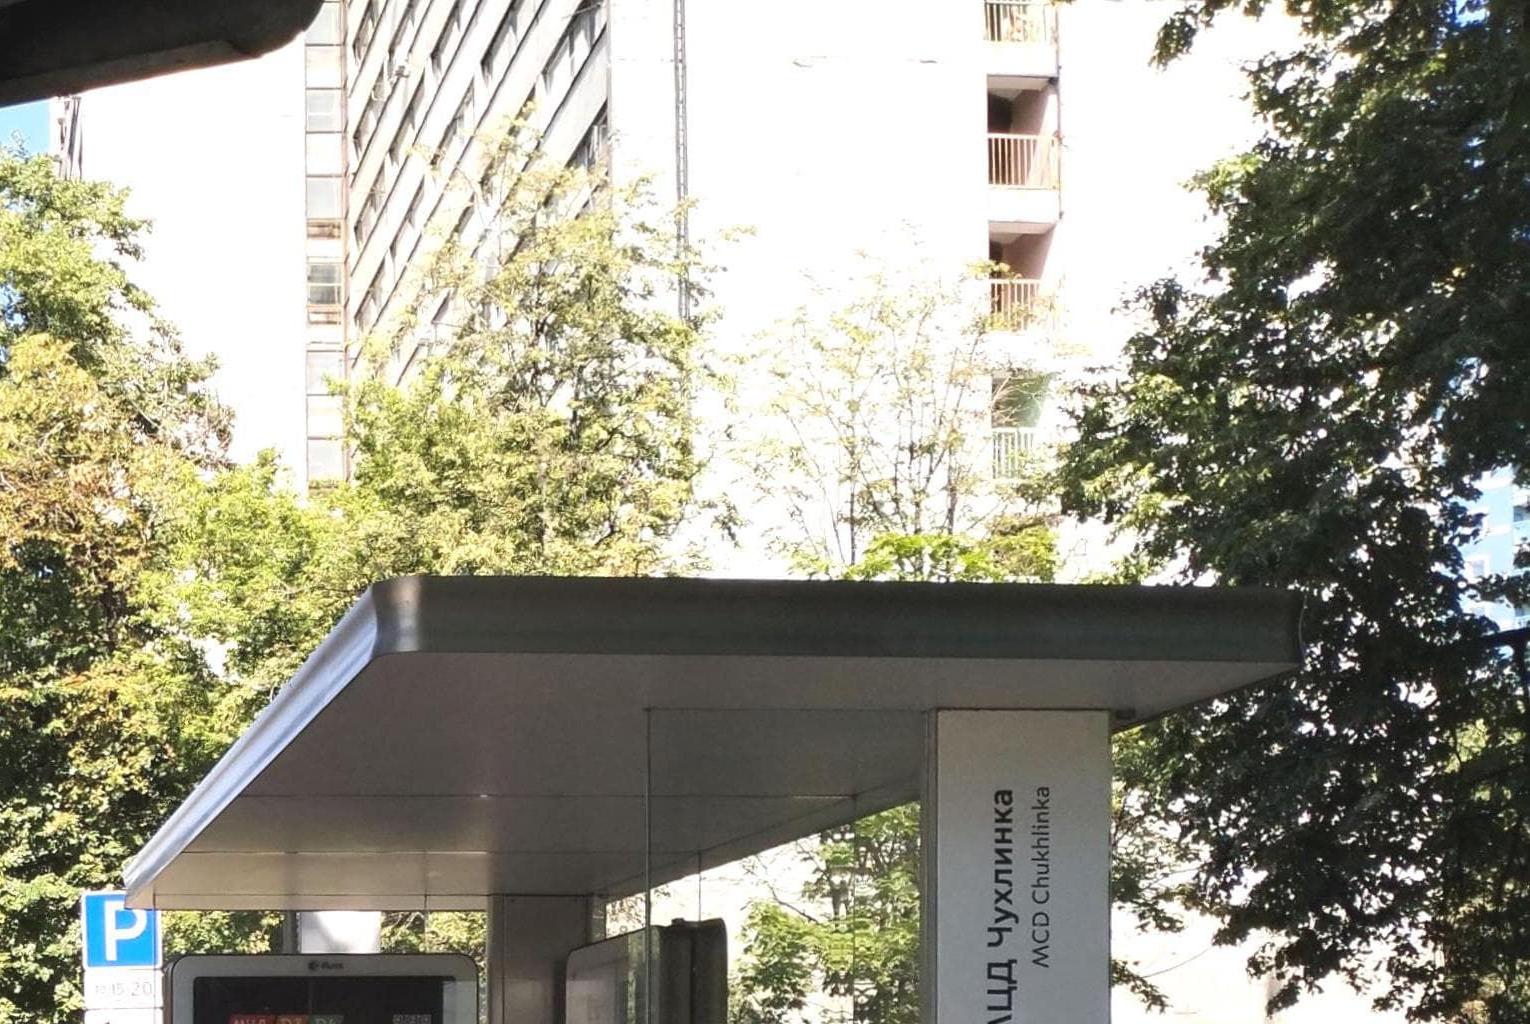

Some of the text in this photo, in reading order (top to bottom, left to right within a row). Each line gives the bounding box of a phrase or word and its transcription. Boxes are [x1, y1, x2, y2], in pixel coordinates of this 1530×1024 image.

[104, 900, 148, 961] P
[986, 788, 1019, 948] Чухлинка
[1030, 786, 1050, 969] MCD Chukhlinka
